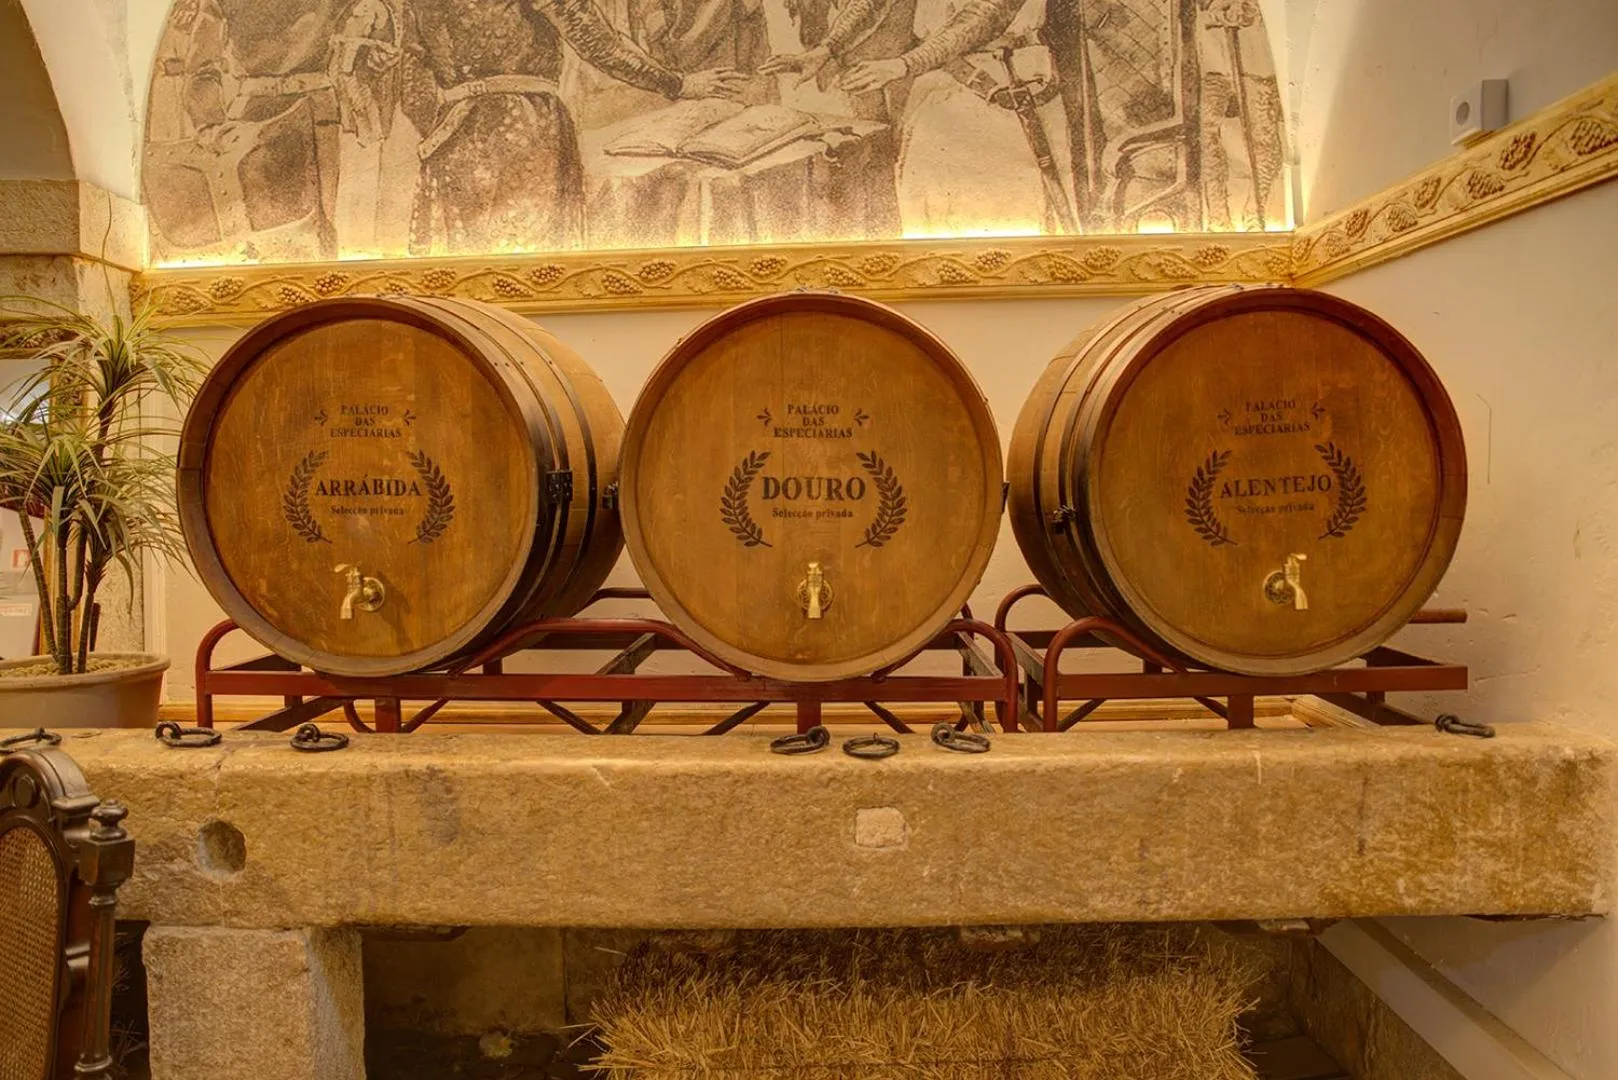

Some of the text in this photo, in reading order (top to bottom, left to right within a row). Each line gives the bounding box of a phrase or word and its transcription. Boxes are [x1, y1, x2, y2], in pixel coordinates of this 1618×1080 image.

[788, 404, 840, 414] PALÁCIO
[355, 416, 375, 426] DAS
[802, 416, 824, 426] DAS
[1261, 413, 1283, 422] DAS
[330, 428, 402, 438] ESPECIARIAS
[774, 427, 852, 438] ESPECIARIAS
[1234, 423, 1310, 436] ESPECIARIAS
[316, 474, 422, 496] ARRÁBIDA
[762, 476, 866, 500] DOURO
[1220, 474, 1332, 498] ALENTEJO
[772, 507, 853, 520] Selecção privada
